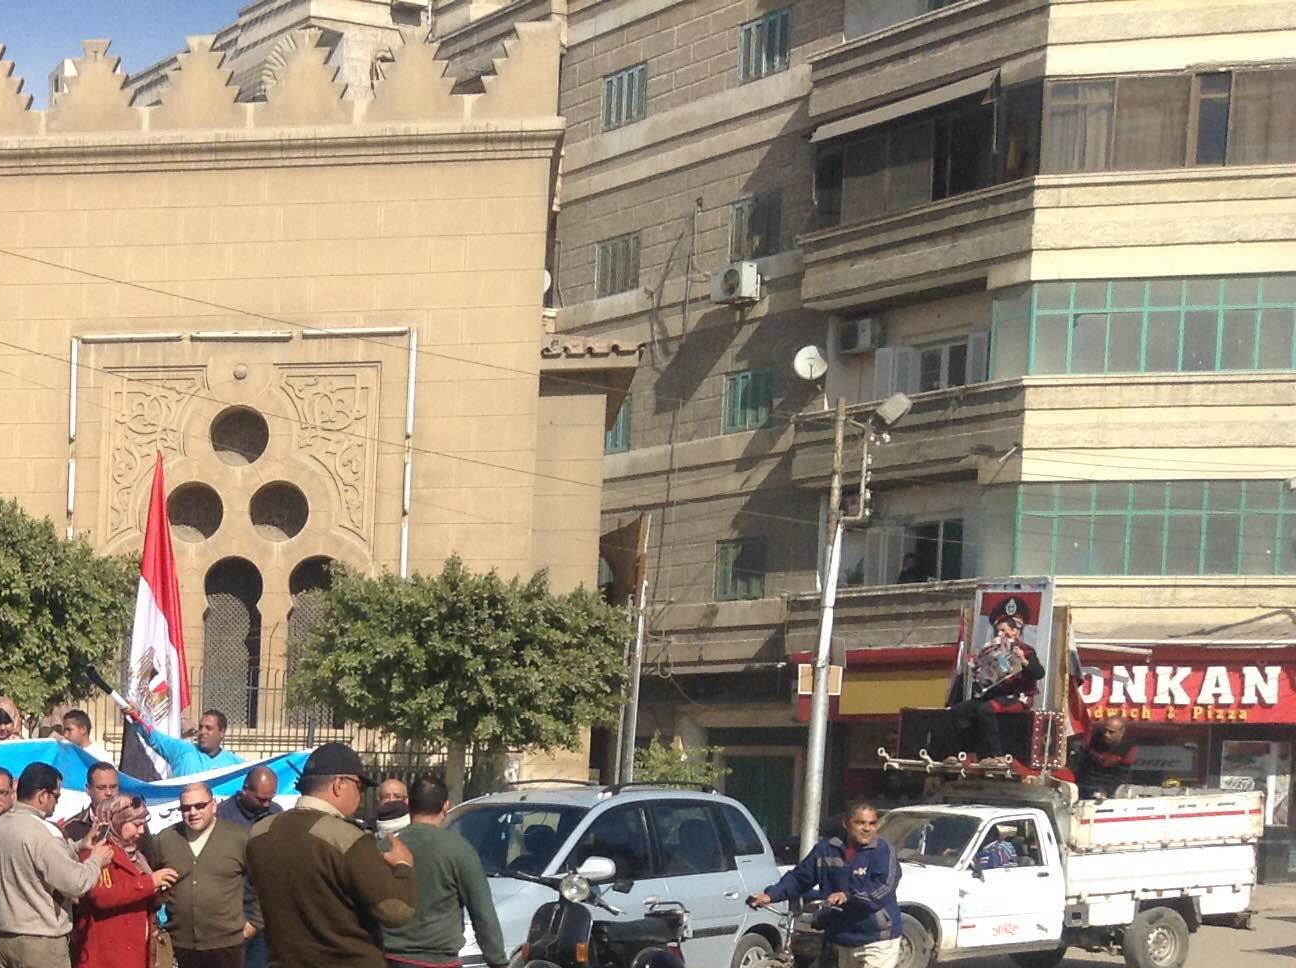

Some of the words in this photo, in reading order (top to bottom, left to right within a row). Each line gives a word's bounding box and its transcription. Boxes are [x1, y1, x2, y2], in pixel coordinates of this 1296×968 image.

[1078, 665, 1281, 704] ONKAN
[1087, 705, 1151, 720] dwich
[1193, 706, 1248, 720] Pizza
